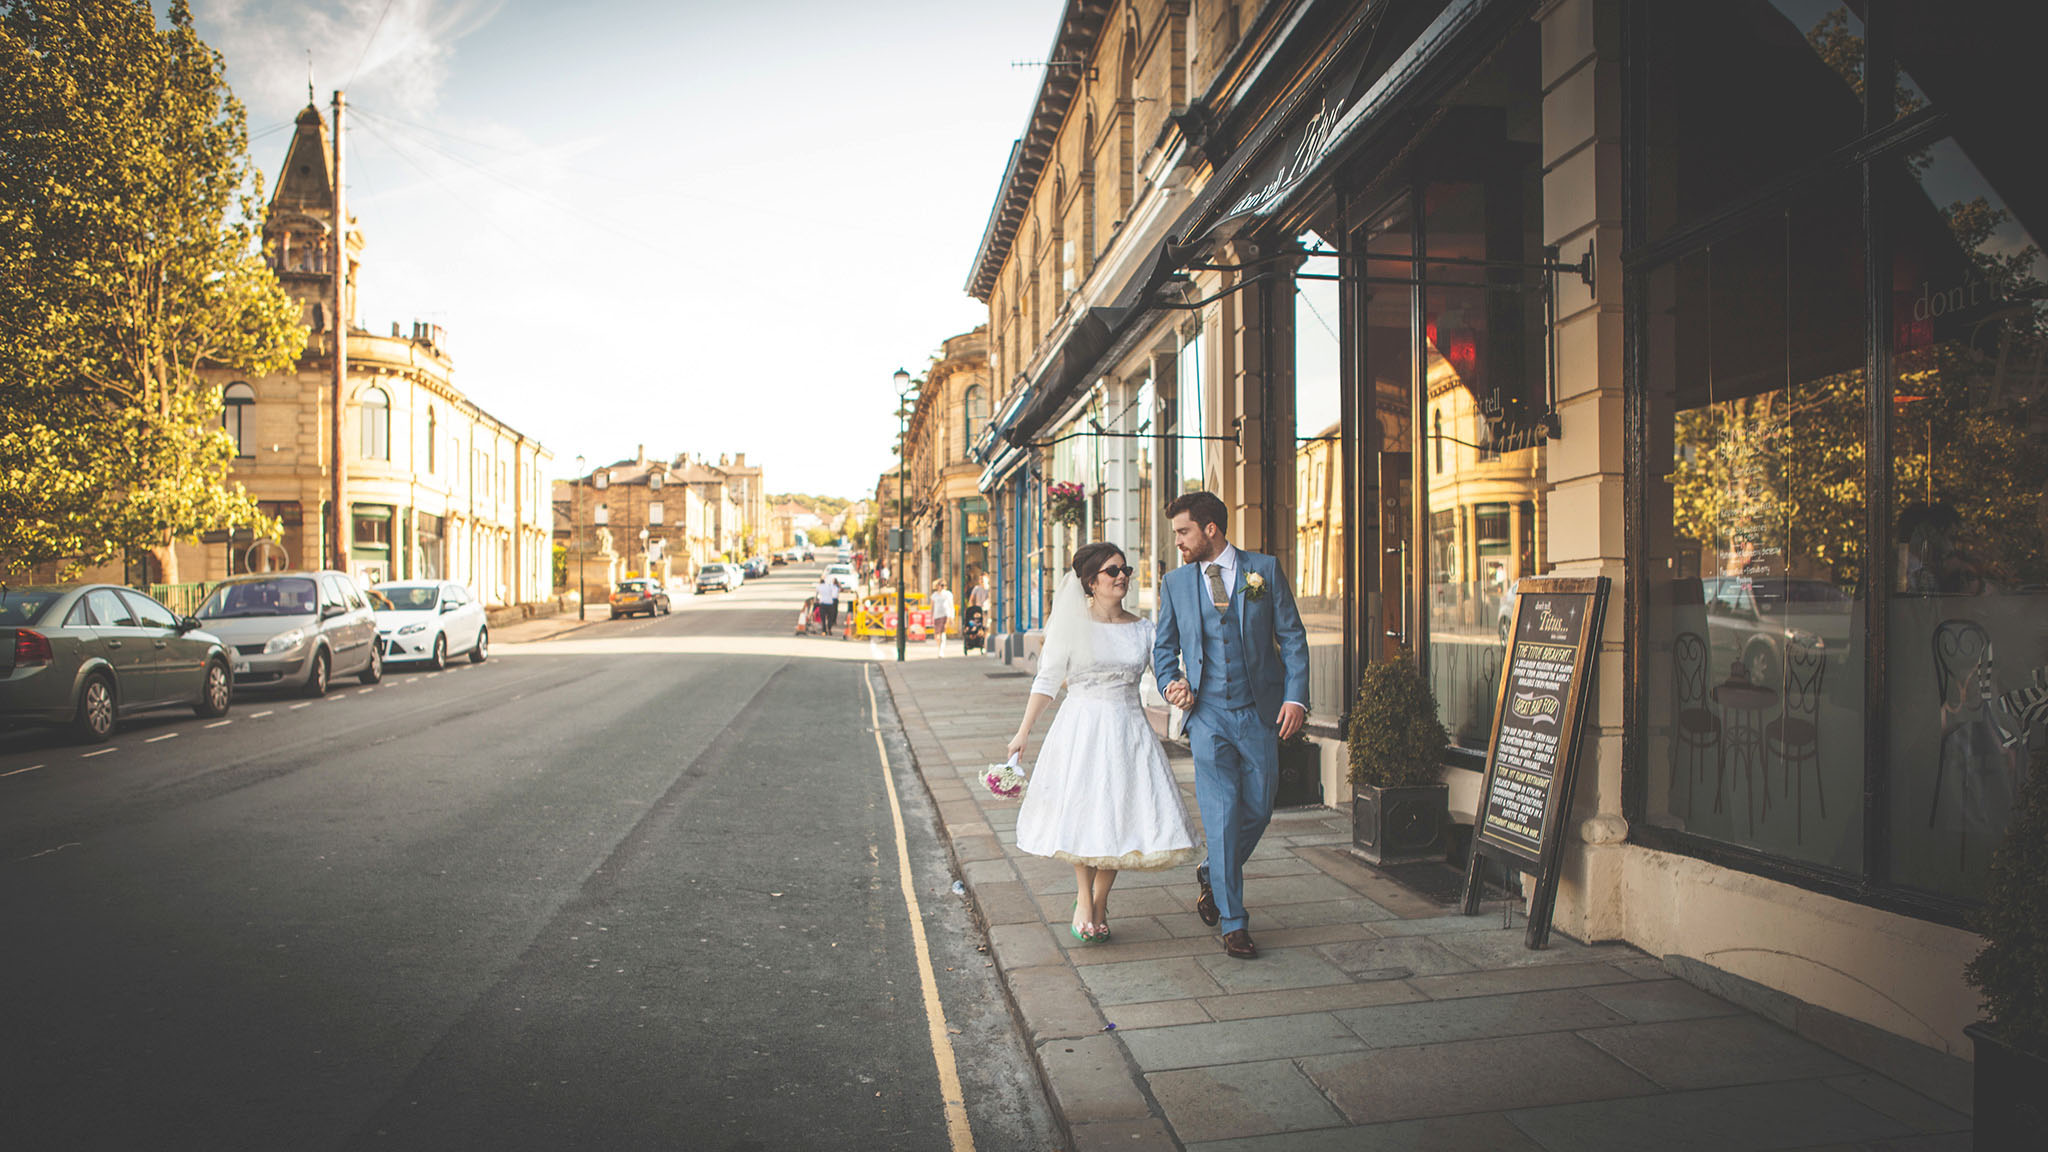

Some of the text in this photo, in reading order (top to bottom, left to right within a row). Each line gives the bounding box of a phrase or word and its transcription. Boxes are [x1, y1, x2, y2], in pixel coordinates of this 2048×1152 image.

[1914, 267, 1980, 321] don't
[1518, 644, 1530, 658] THE
[1529, 645, 1545, 660] TITUS
[1515, 698, 1558, 716] GREAT BAR FOOD
